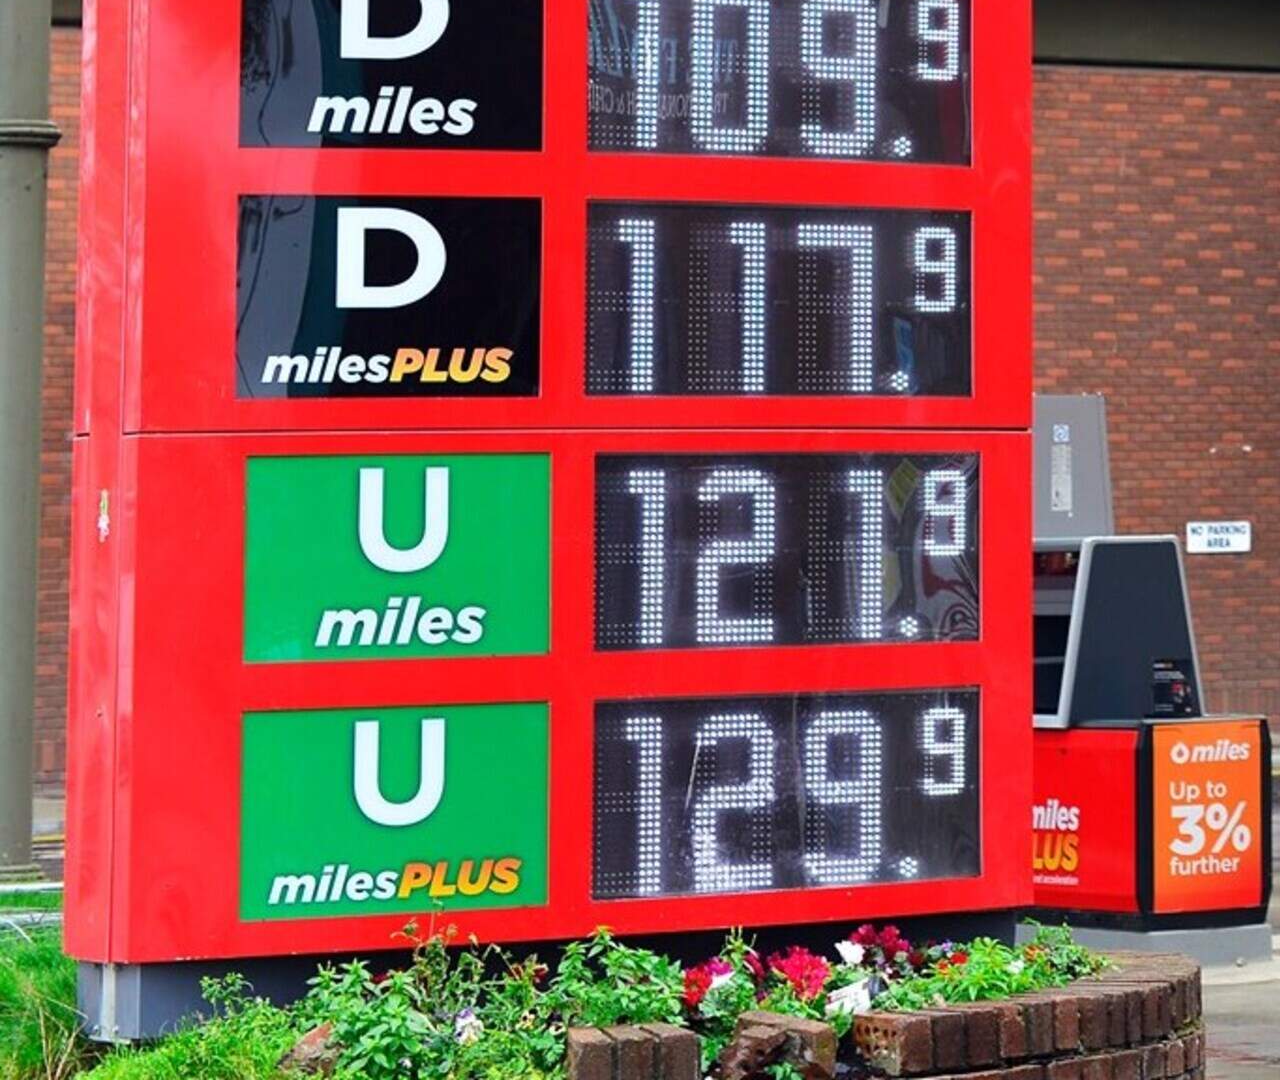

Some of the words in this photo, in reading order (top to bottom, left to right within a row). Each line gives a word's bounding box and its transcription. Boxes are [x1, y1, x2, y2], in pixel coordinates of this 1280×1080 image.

[306, 85, 477, 137] miles
[335, 206, 448, 310] D
[261, 344, 514, 387] milesPLUS
[359, 466, 450, 573] U
[1207, 536, 1231, 548] AREA
[314, 595, 486, 649] miles
[352, 717, 446, 827] U
[1191, 738, 1251, 764] miles
[1169, 780, 1201, 802] Up
[1206, 780, 1228, 799] to
[1032, 833, 1080, 871] LUS
[1169, 800, 1252, 856] 3%
[268, 856, 523, 907] milesPLUS
[1169, 855, 1241, 877] further
